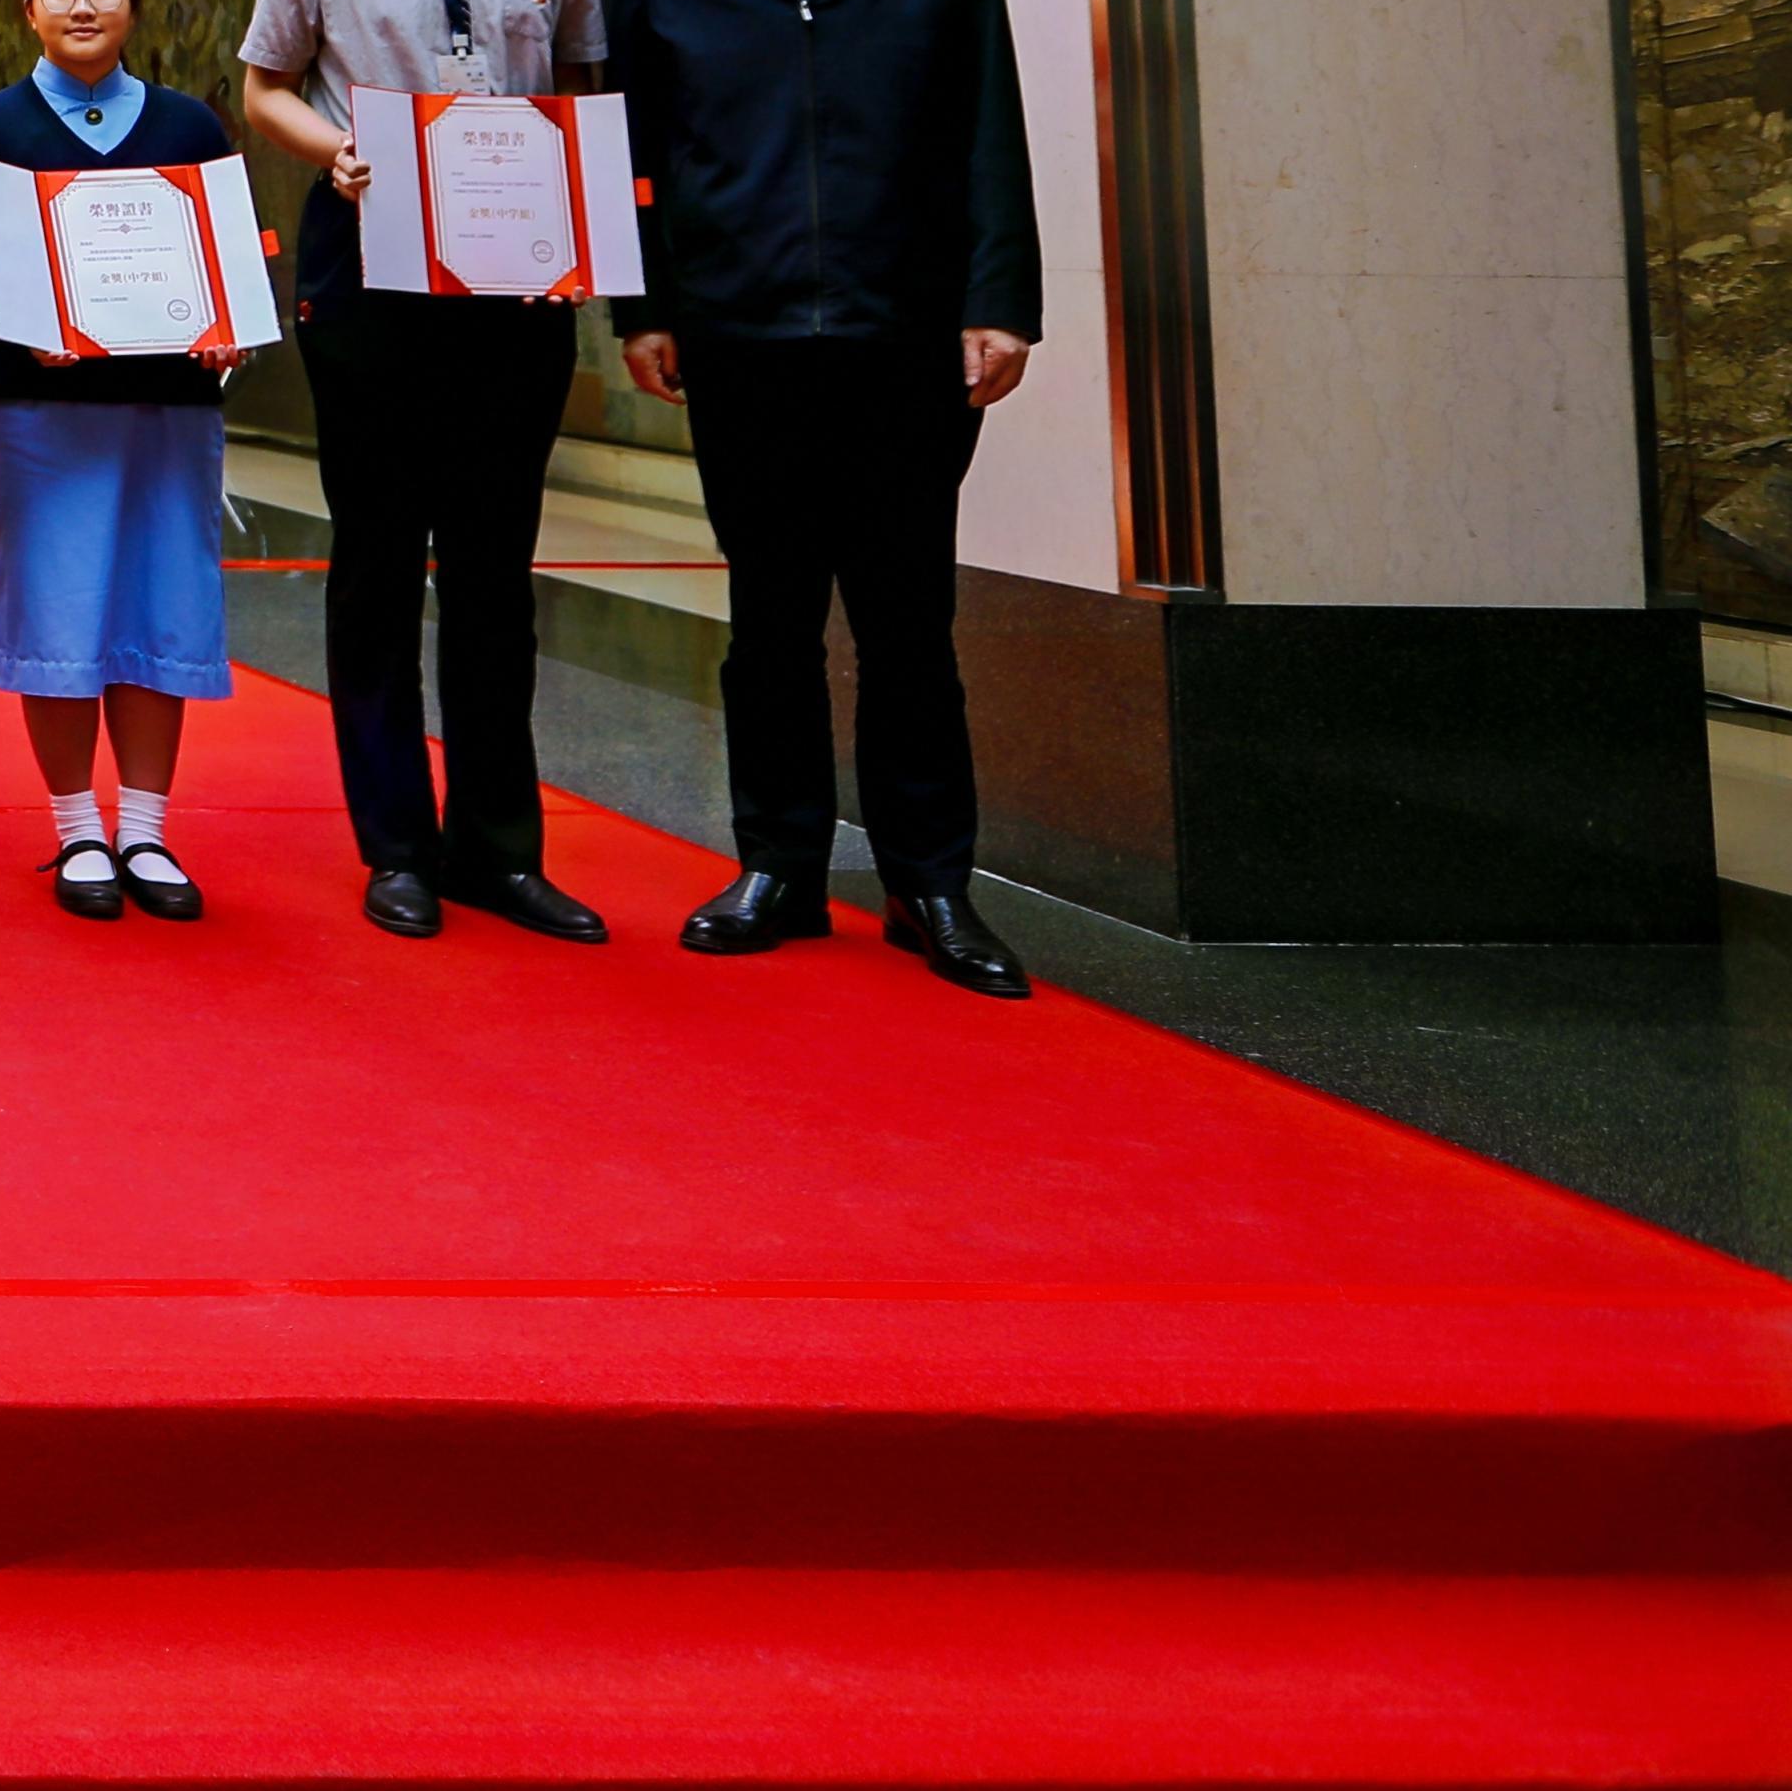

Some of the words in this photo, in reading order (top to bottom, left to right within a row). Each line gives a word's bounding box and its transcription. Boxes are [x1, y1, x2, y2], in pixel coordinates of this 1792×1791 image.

[463, 130, 527, 148] 榮譽證書
[89, 201, 154, 218] 榮譽證書
